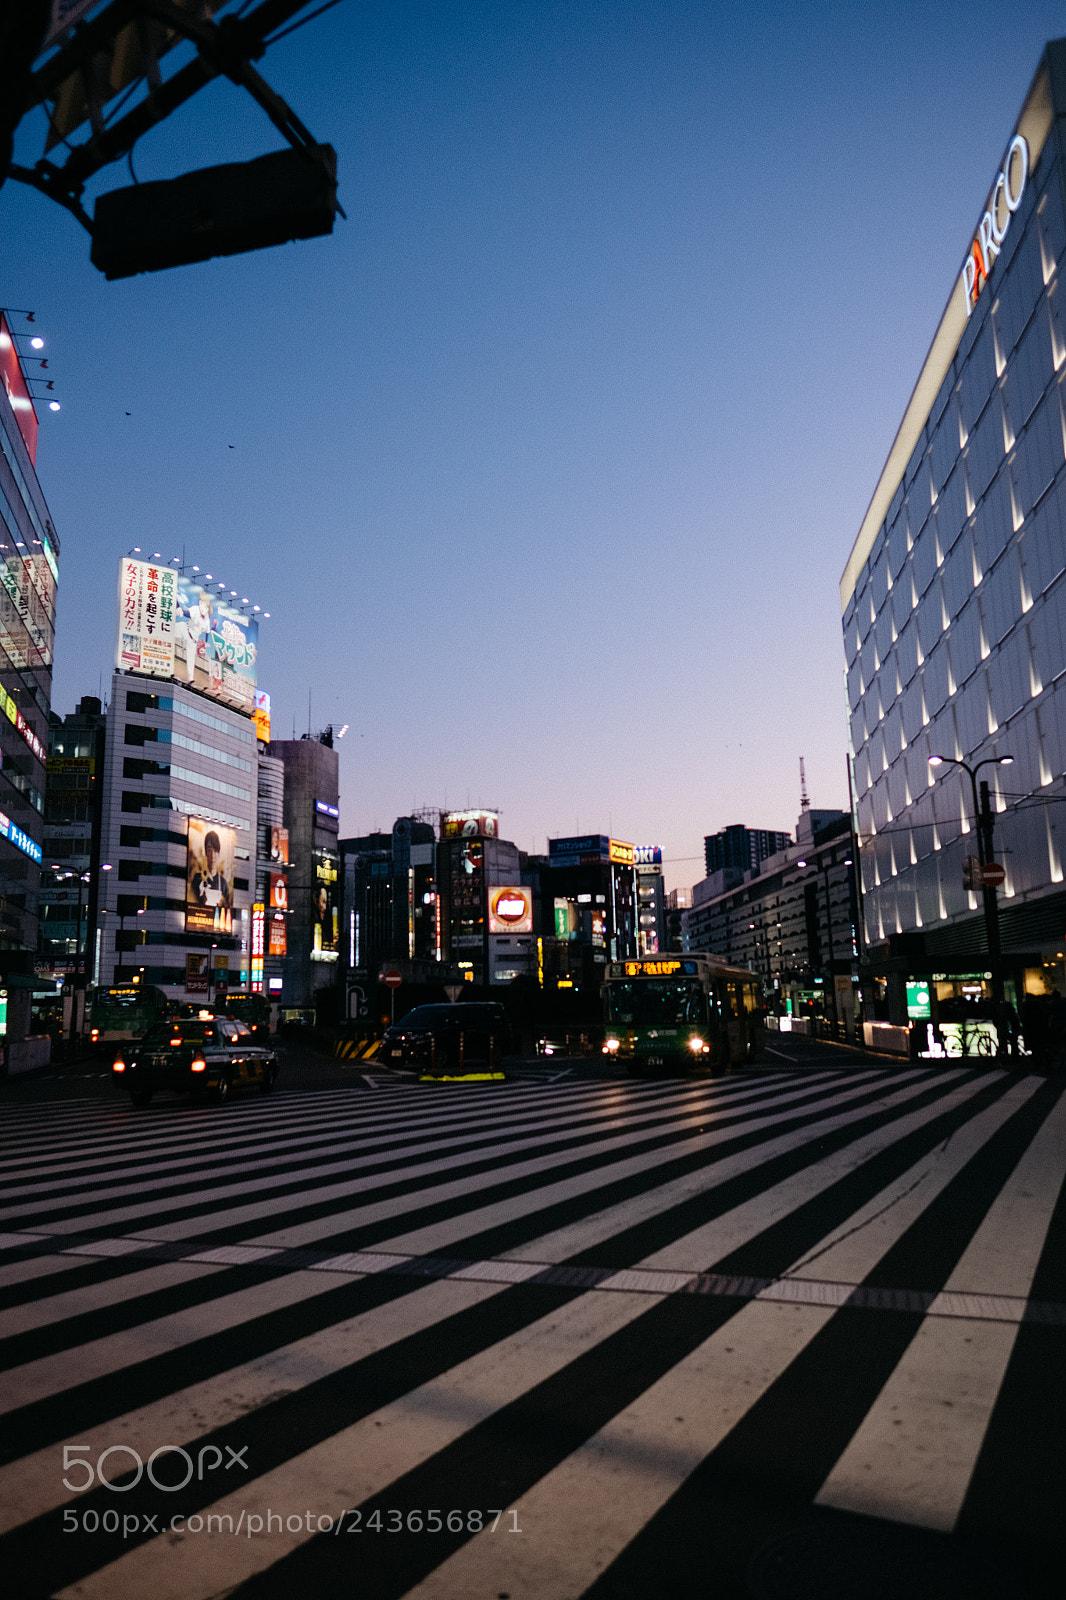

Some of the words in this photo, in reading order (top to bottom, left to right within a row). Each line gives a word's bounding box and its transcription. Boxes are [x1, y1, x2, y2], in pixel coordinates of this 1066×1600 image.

[962, 134, 1029, 317] PARCO
[145, 567, 160, 635] 革命を起こす
[159, 571, 174, 633] 高校野球に
[211, 630, 257, 667] マウンド
